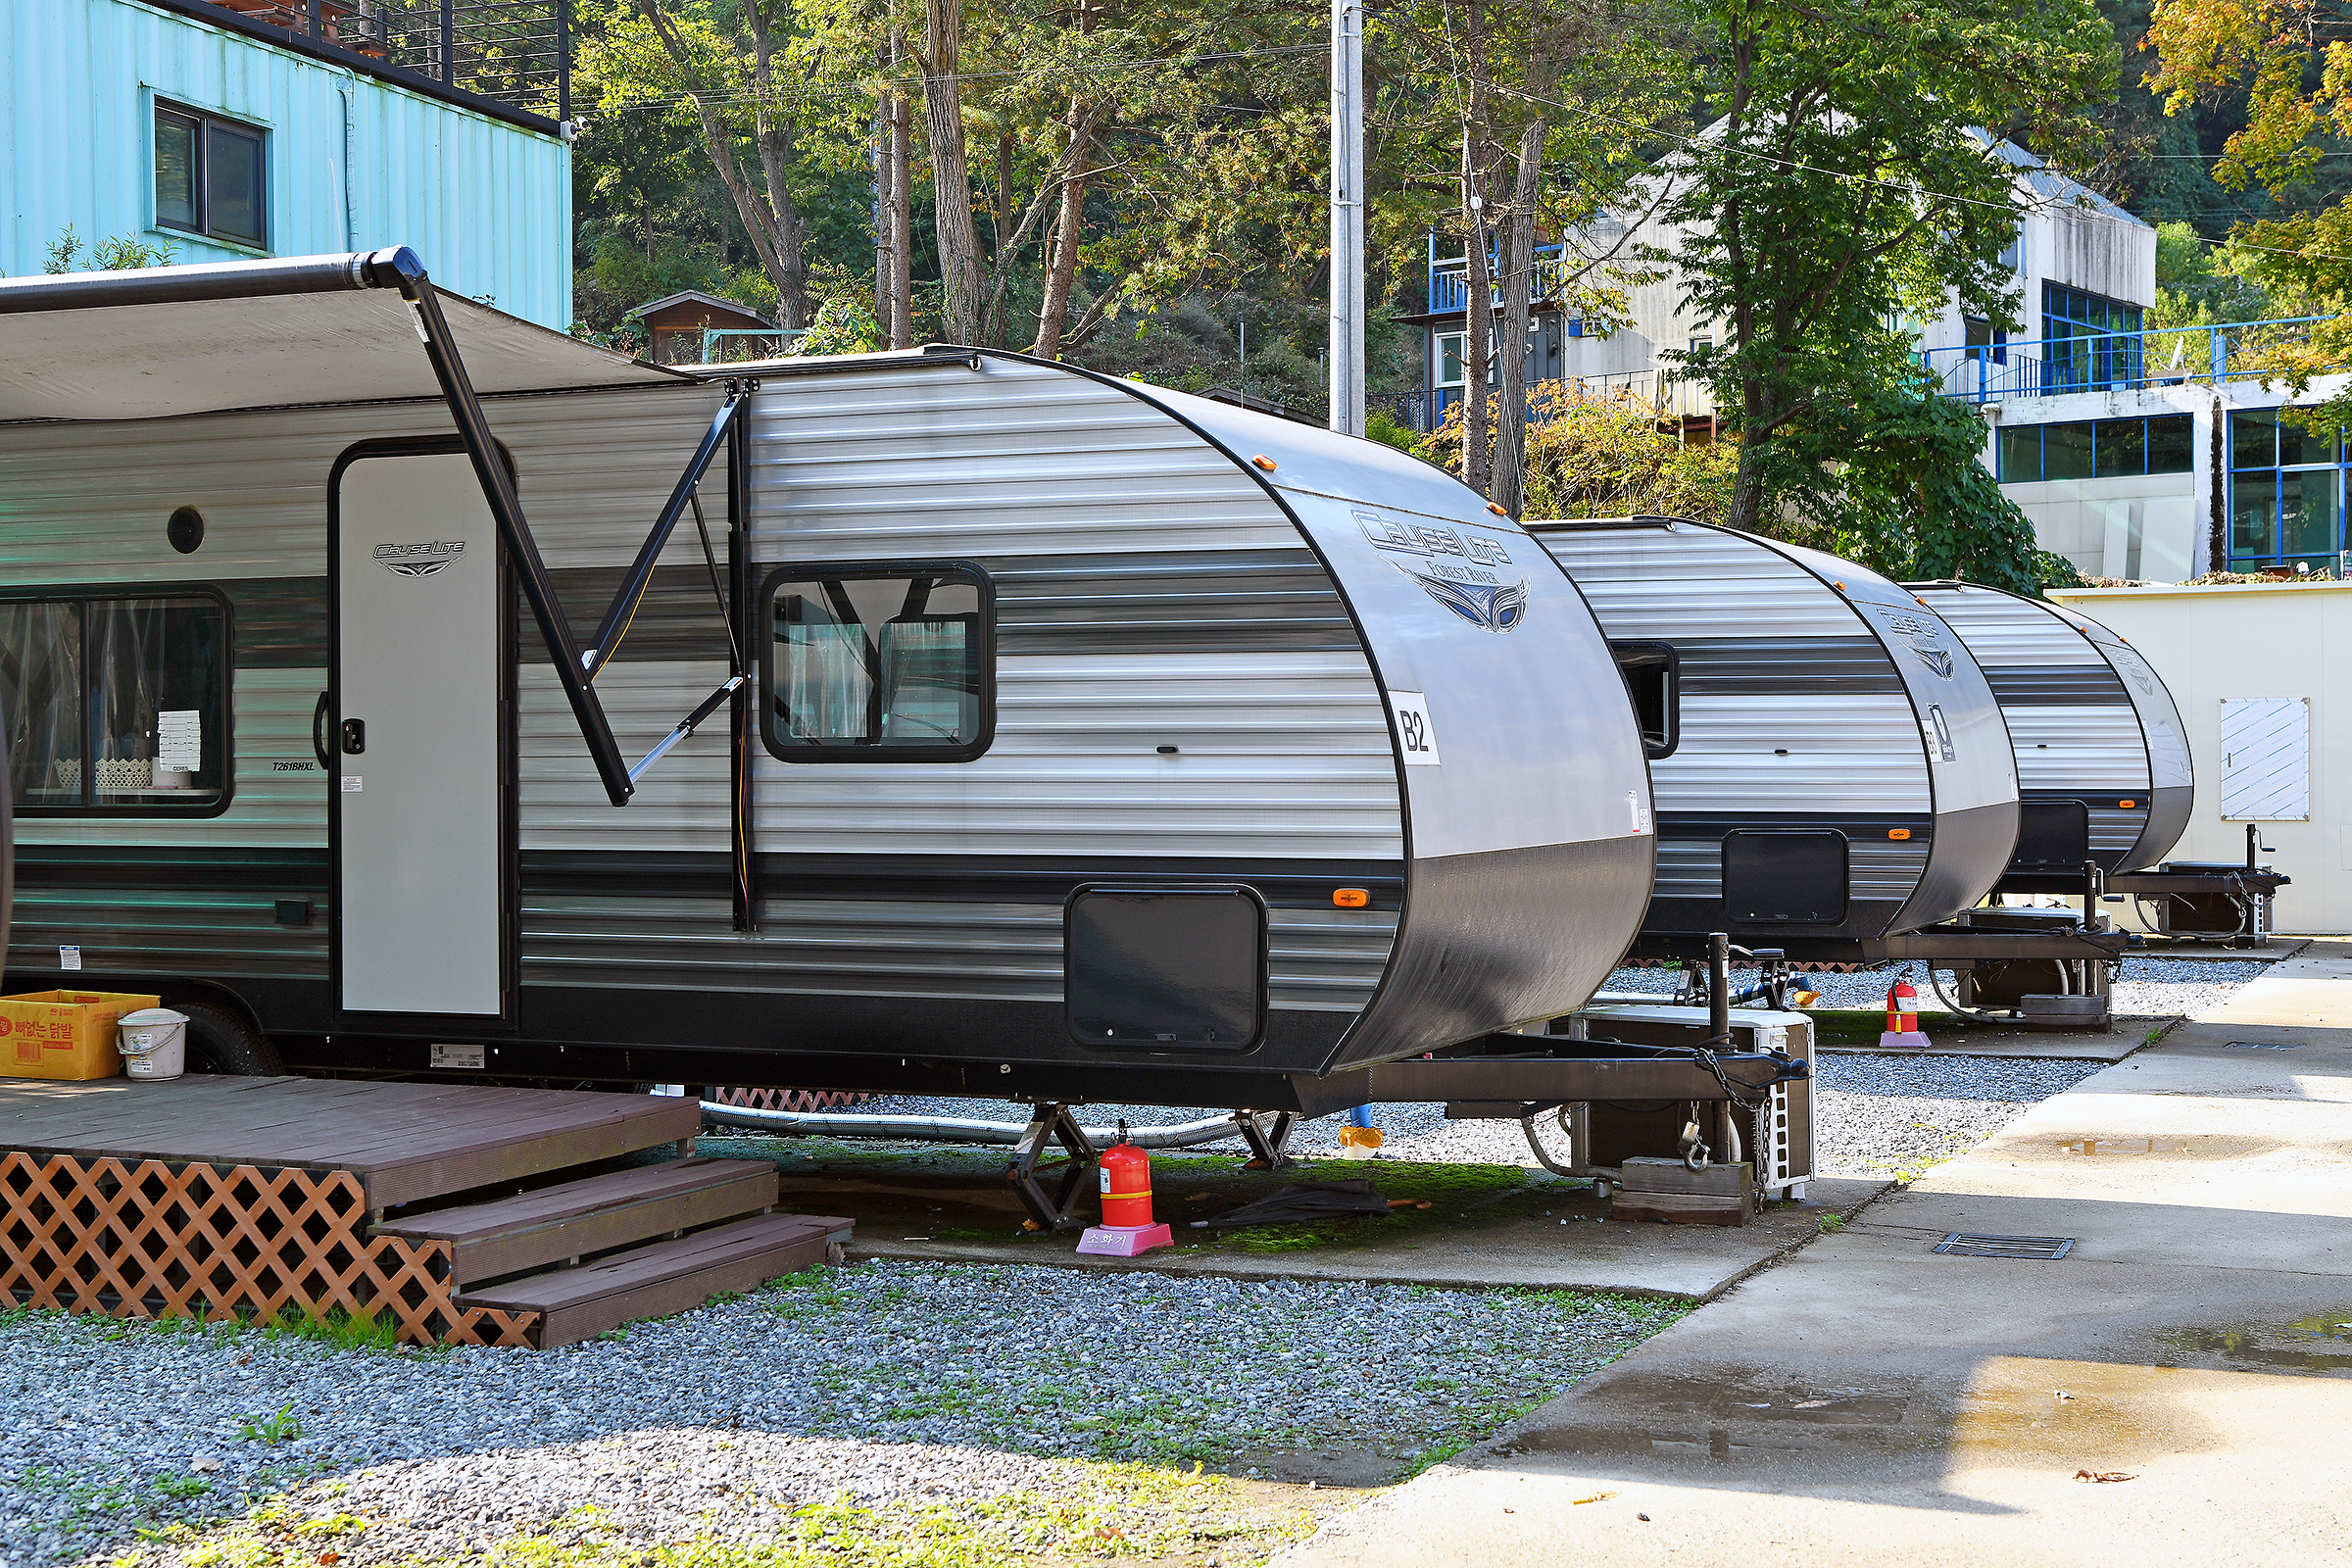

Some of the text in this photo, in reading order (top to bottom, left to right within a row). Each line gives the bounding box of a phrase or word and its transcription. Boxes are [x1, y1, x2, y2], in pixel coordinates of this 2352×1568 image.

[1425, 560, 1500, 585] FOREST RIVER
[1399, 710, 1429, 752] B2
[272, 761, 315, 771] T261BHXL
[15, 1021, 74, 1039] 뼈없는 닭발
[1087, 1233, 1127, 1247] 소화기
